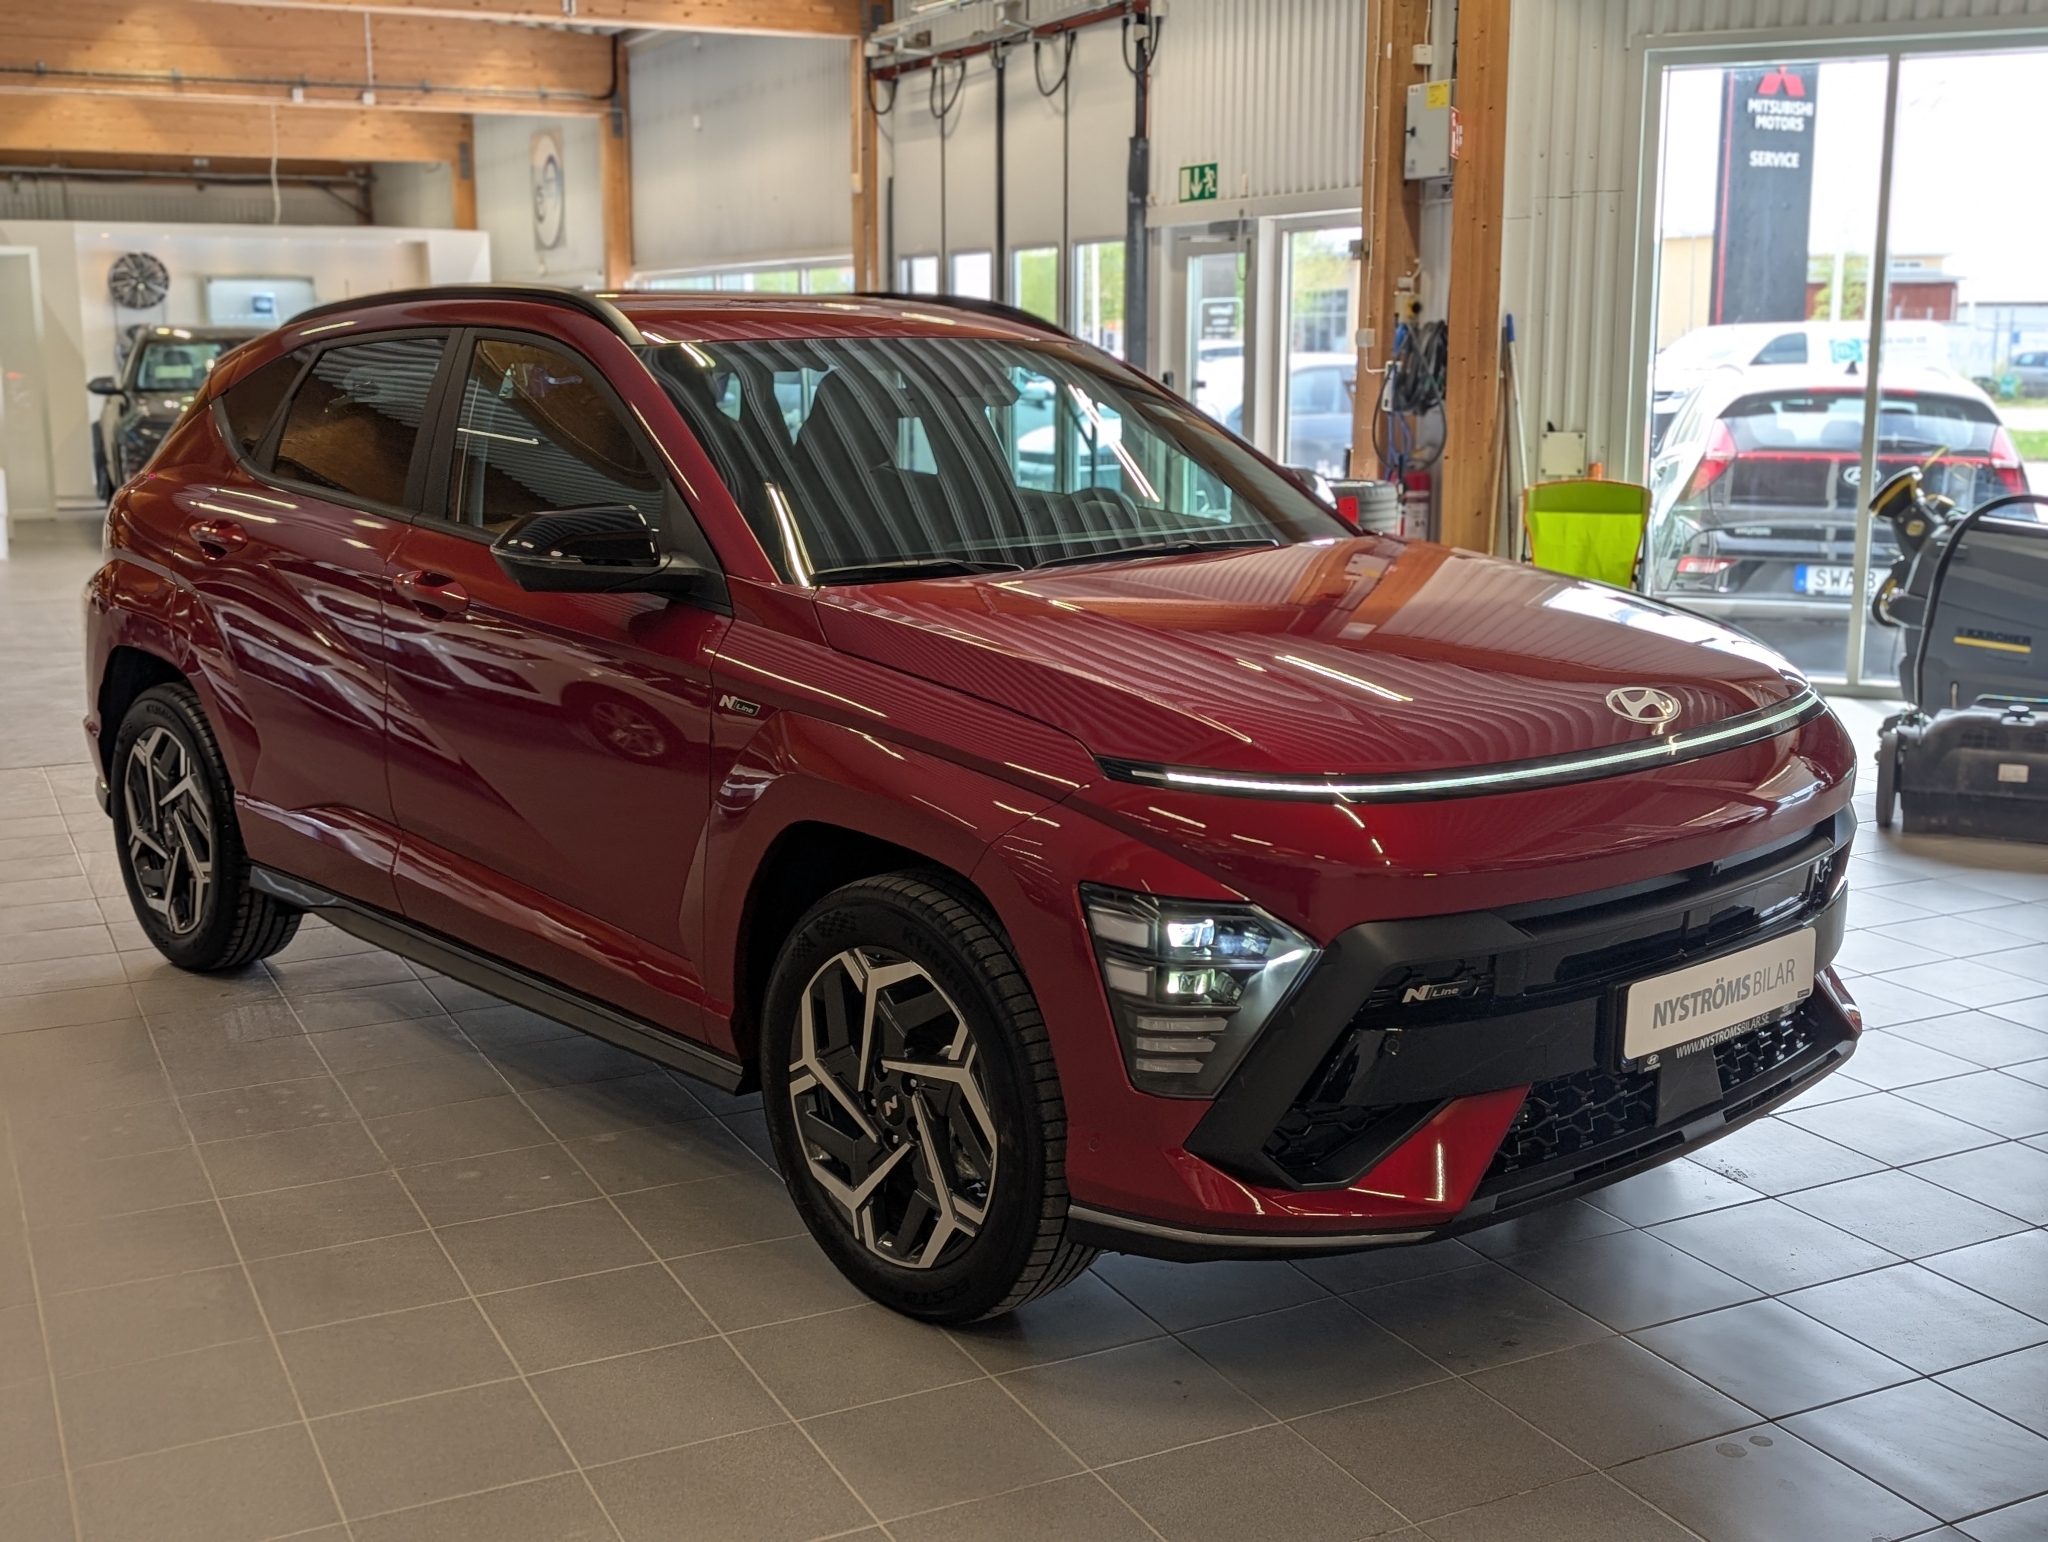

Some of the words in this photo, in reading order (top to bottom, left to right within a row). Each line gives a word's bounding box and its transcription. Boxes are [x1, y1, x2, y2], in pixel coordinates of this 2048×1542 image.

[1747, 98, 1814, 117] MITSUBISHI
[1755, 114, 1804, 132] MOTORS
[1749, 150, 1800, 168] SERVICE
[719, 694, 737, 710] N
[736, 704, 754, 714] Line
[1401, 984, 1430, 1003] N
[1432, 988, 1459, 997] Line
[1652, 974, 1752, 1029] NYSTRÖMS
[1753, 958, 1796, 997] BILAR
